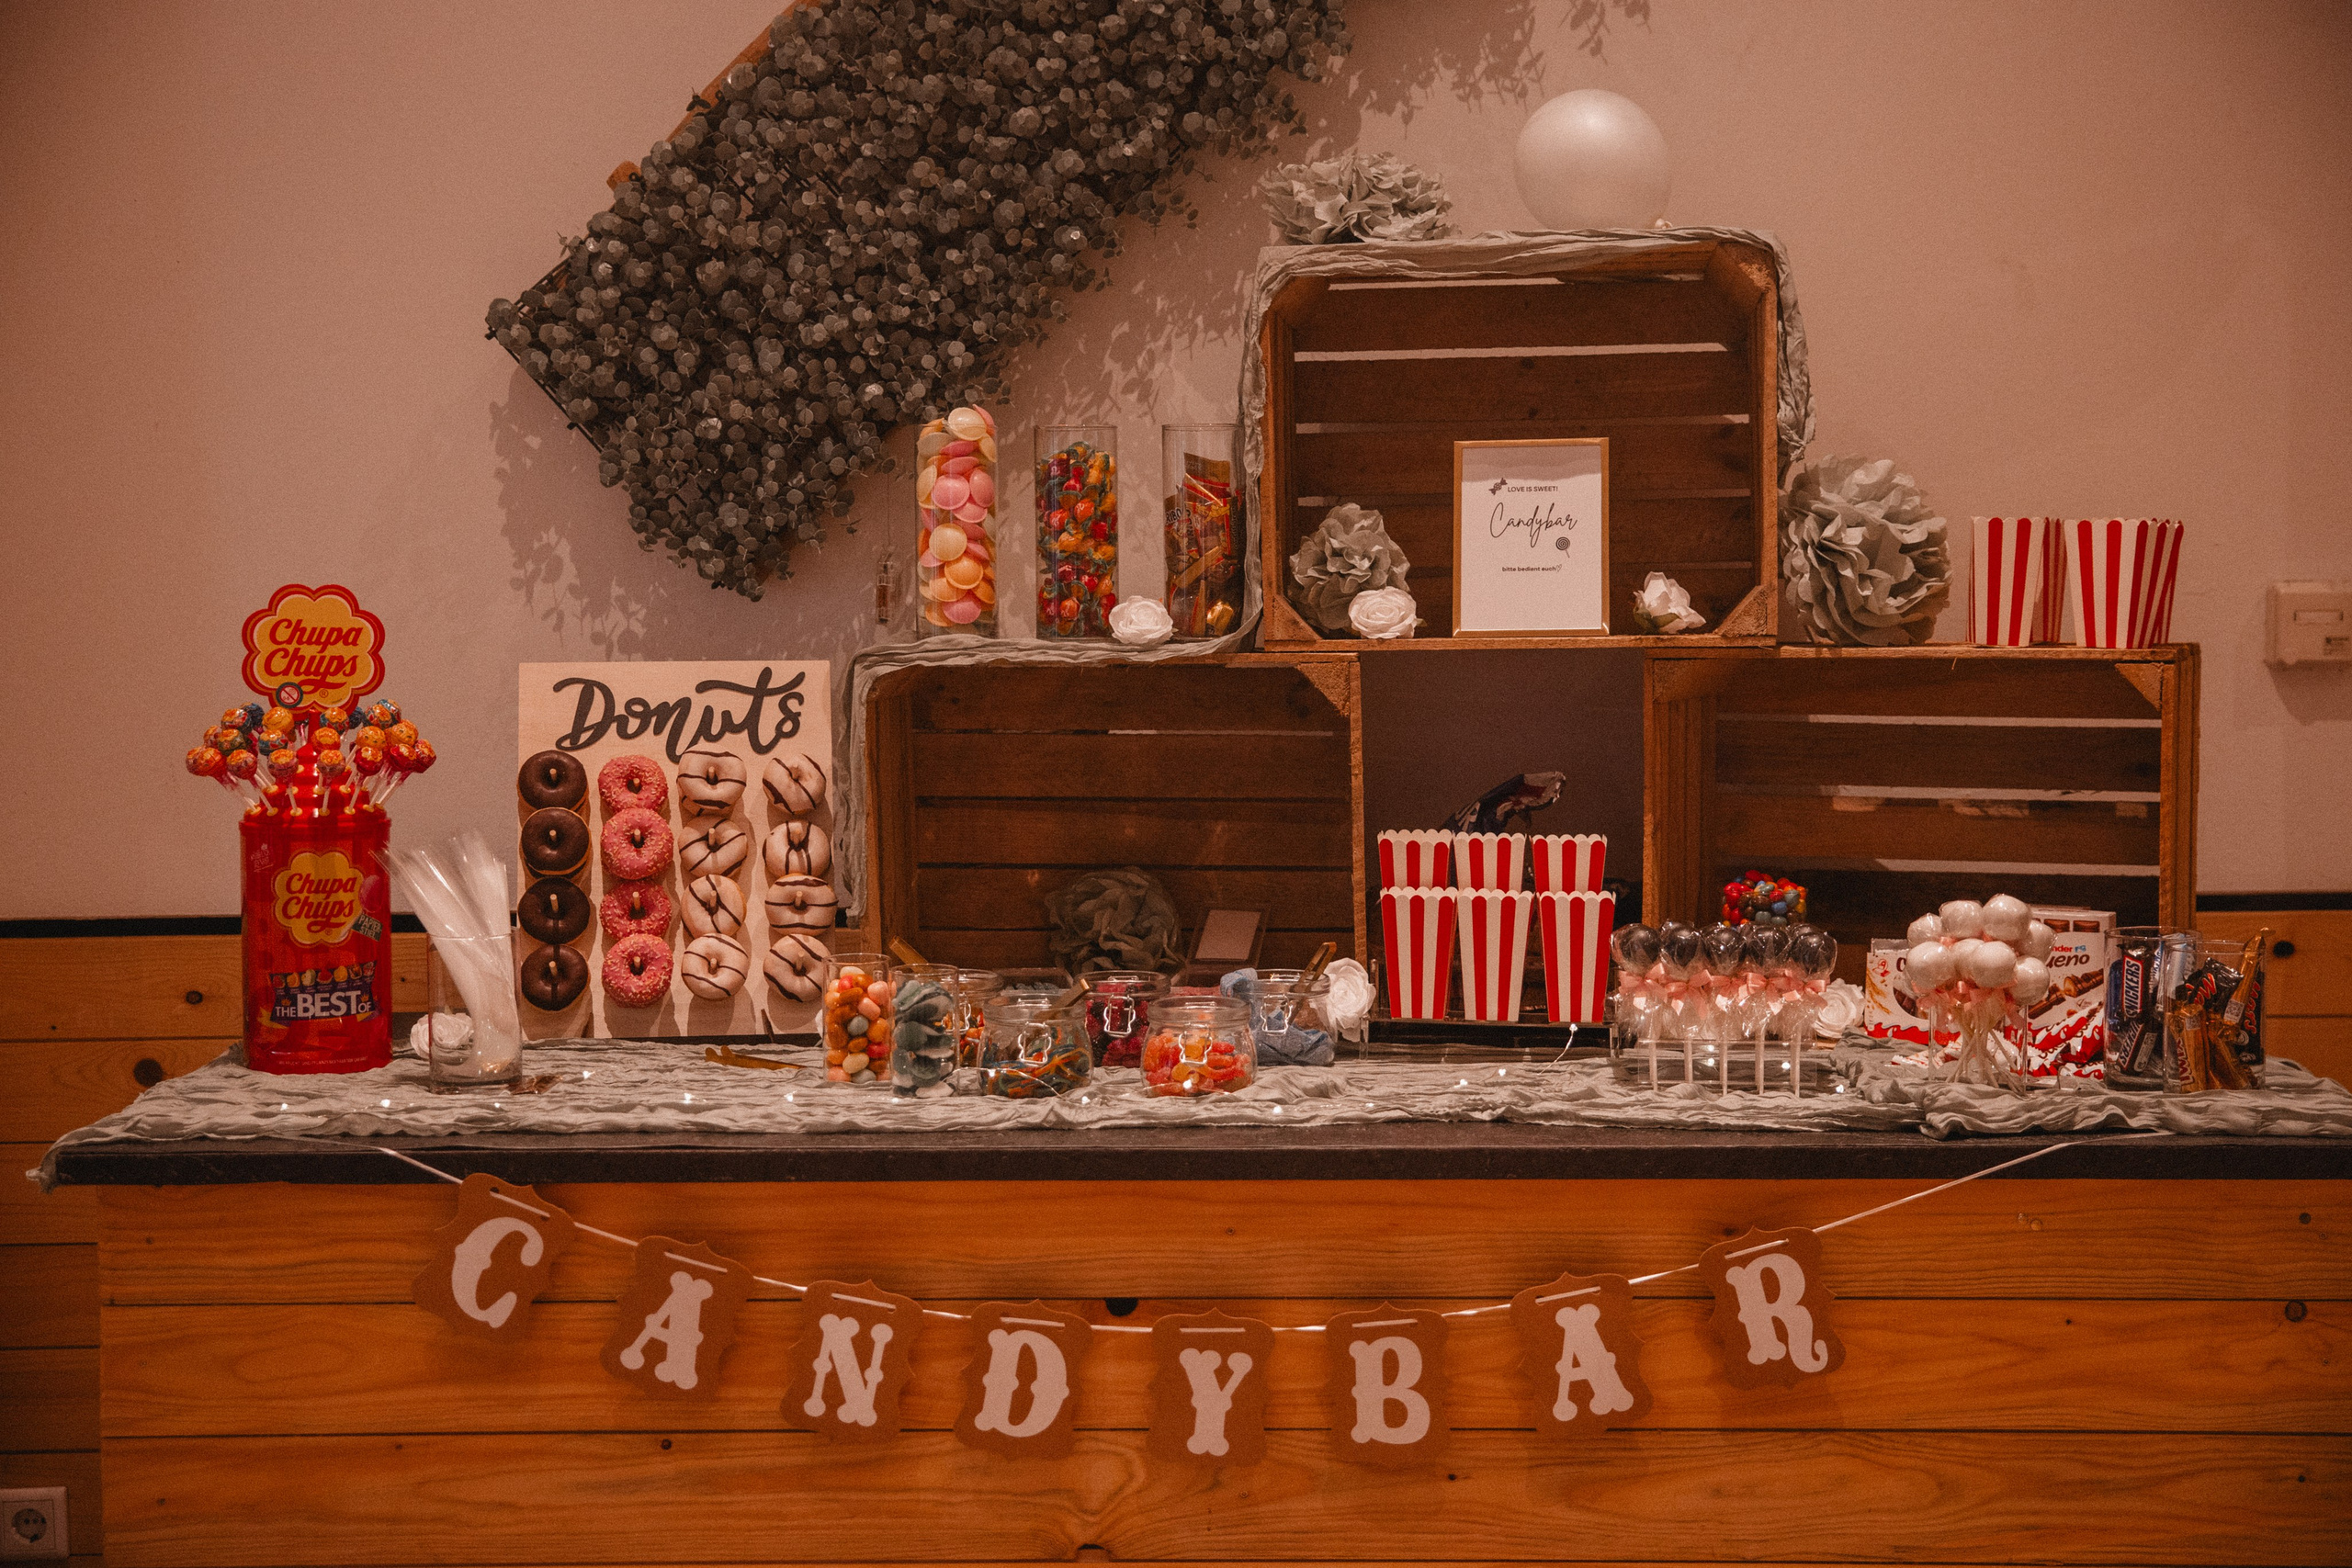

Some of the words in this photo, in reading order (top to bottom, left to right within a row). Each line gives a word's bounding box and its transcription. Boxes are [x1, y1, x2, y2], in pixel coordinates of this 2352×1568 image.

[1490, 502, 1577, 547] Candybar
[268, 618, 364, 653] Chupa
[264, 647, 359, 694] Chups
[552, 666, 806, 764] Donuts
[285, 873, 358, 897] Chupa
[281, 896, 356, 933] Chups
[2046, 953, 2090, 968] ueno
[276, 1006, 296, 1017] THE
[297, 990, 361, 1018] BEST
[357, 1001, 372, 1013] OF
[2125, 960, 2141, 1017] SNICKERS
